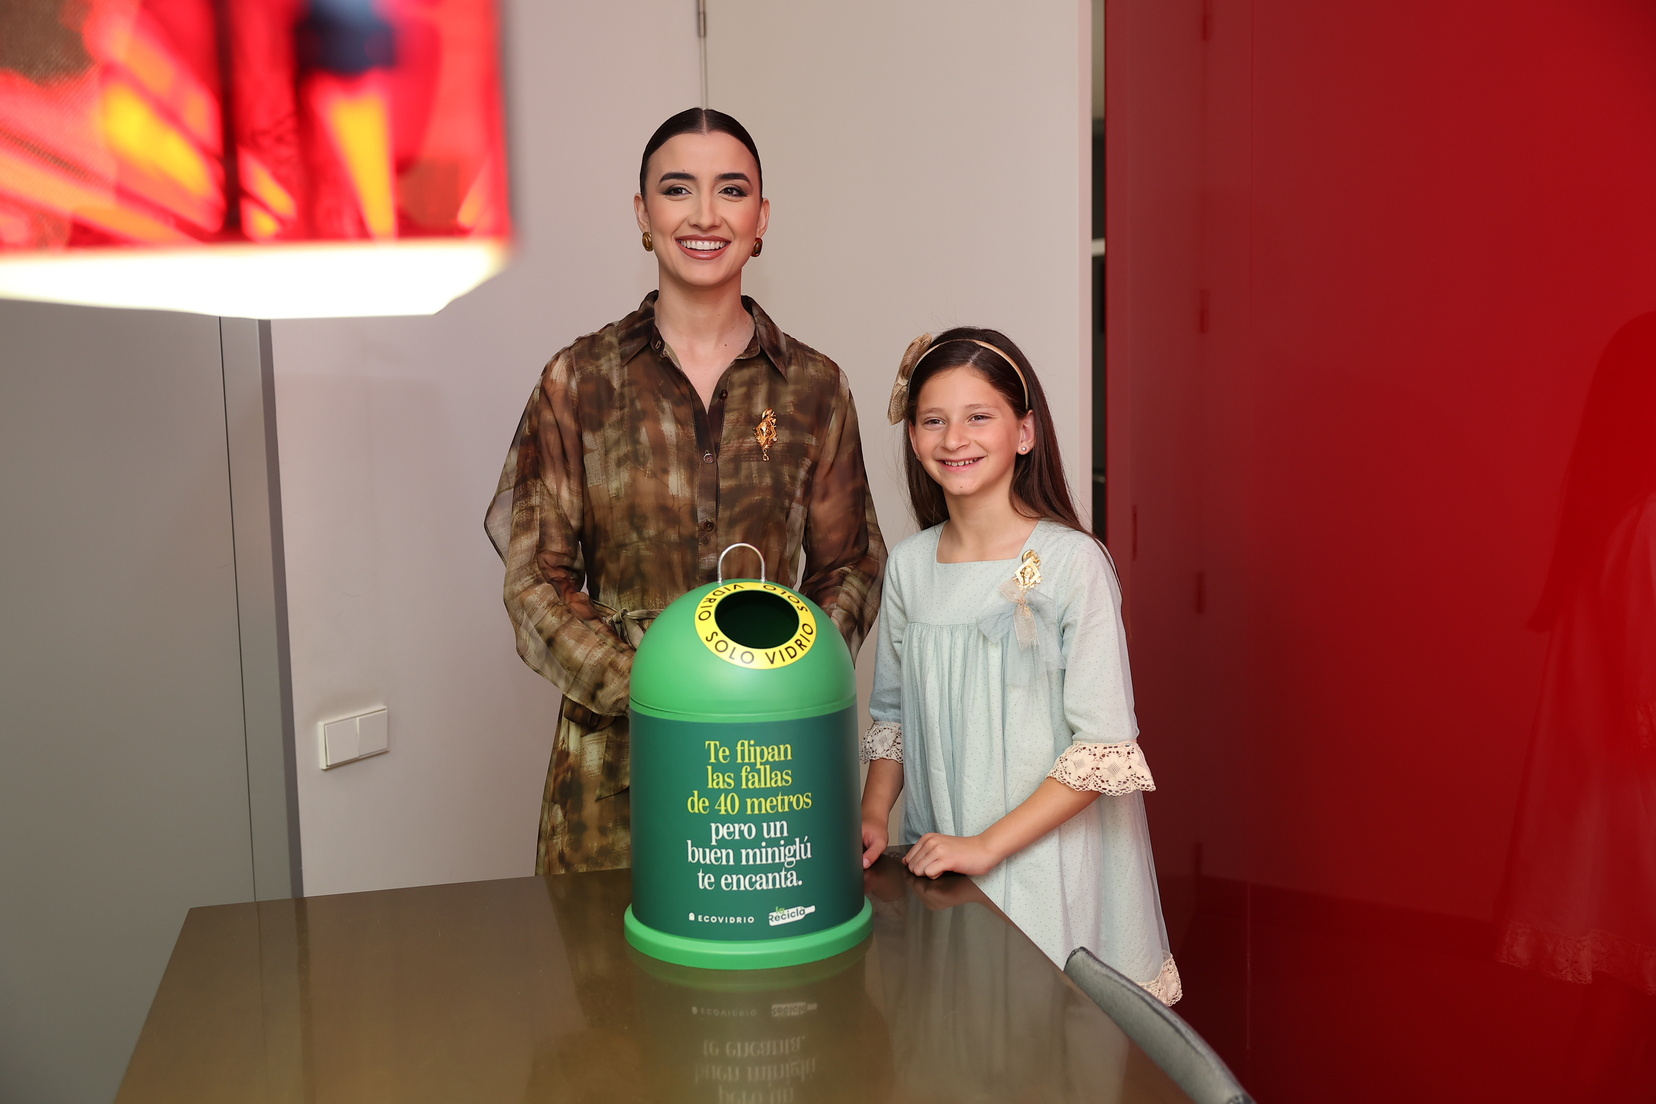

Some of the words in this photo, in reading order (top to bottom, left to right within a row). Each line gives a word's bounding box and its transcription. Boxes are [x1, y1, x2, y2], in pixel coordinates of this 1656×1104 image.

[698, 584, 744, 621] VIDRIO
[763, 584, 809, 613] SOLO
[705, 631, 755, 665] SOLO
[765, 622, 814, 665] VIDRIO
[705, 740, 730, 763] Te
[736, 739, 793, 768] flipan
[706, 765, 735, 789] las
[741, 765, 793, 789] fallas
[687, 791, 710, 814] de
[715, 792, 740, 815] 40
[746, 791, 812, 815] metros
[710, 821, 756, 845] pero
[762, 820, 789, 838] un
[687, 840, 735, 865] buen
[741, 836, 812, 868] miniglú
[698, 868, 715, 890] te
[721, 867, 803, 891] encanta.
[698, 914, 755, 924] ECOVIDRIO
